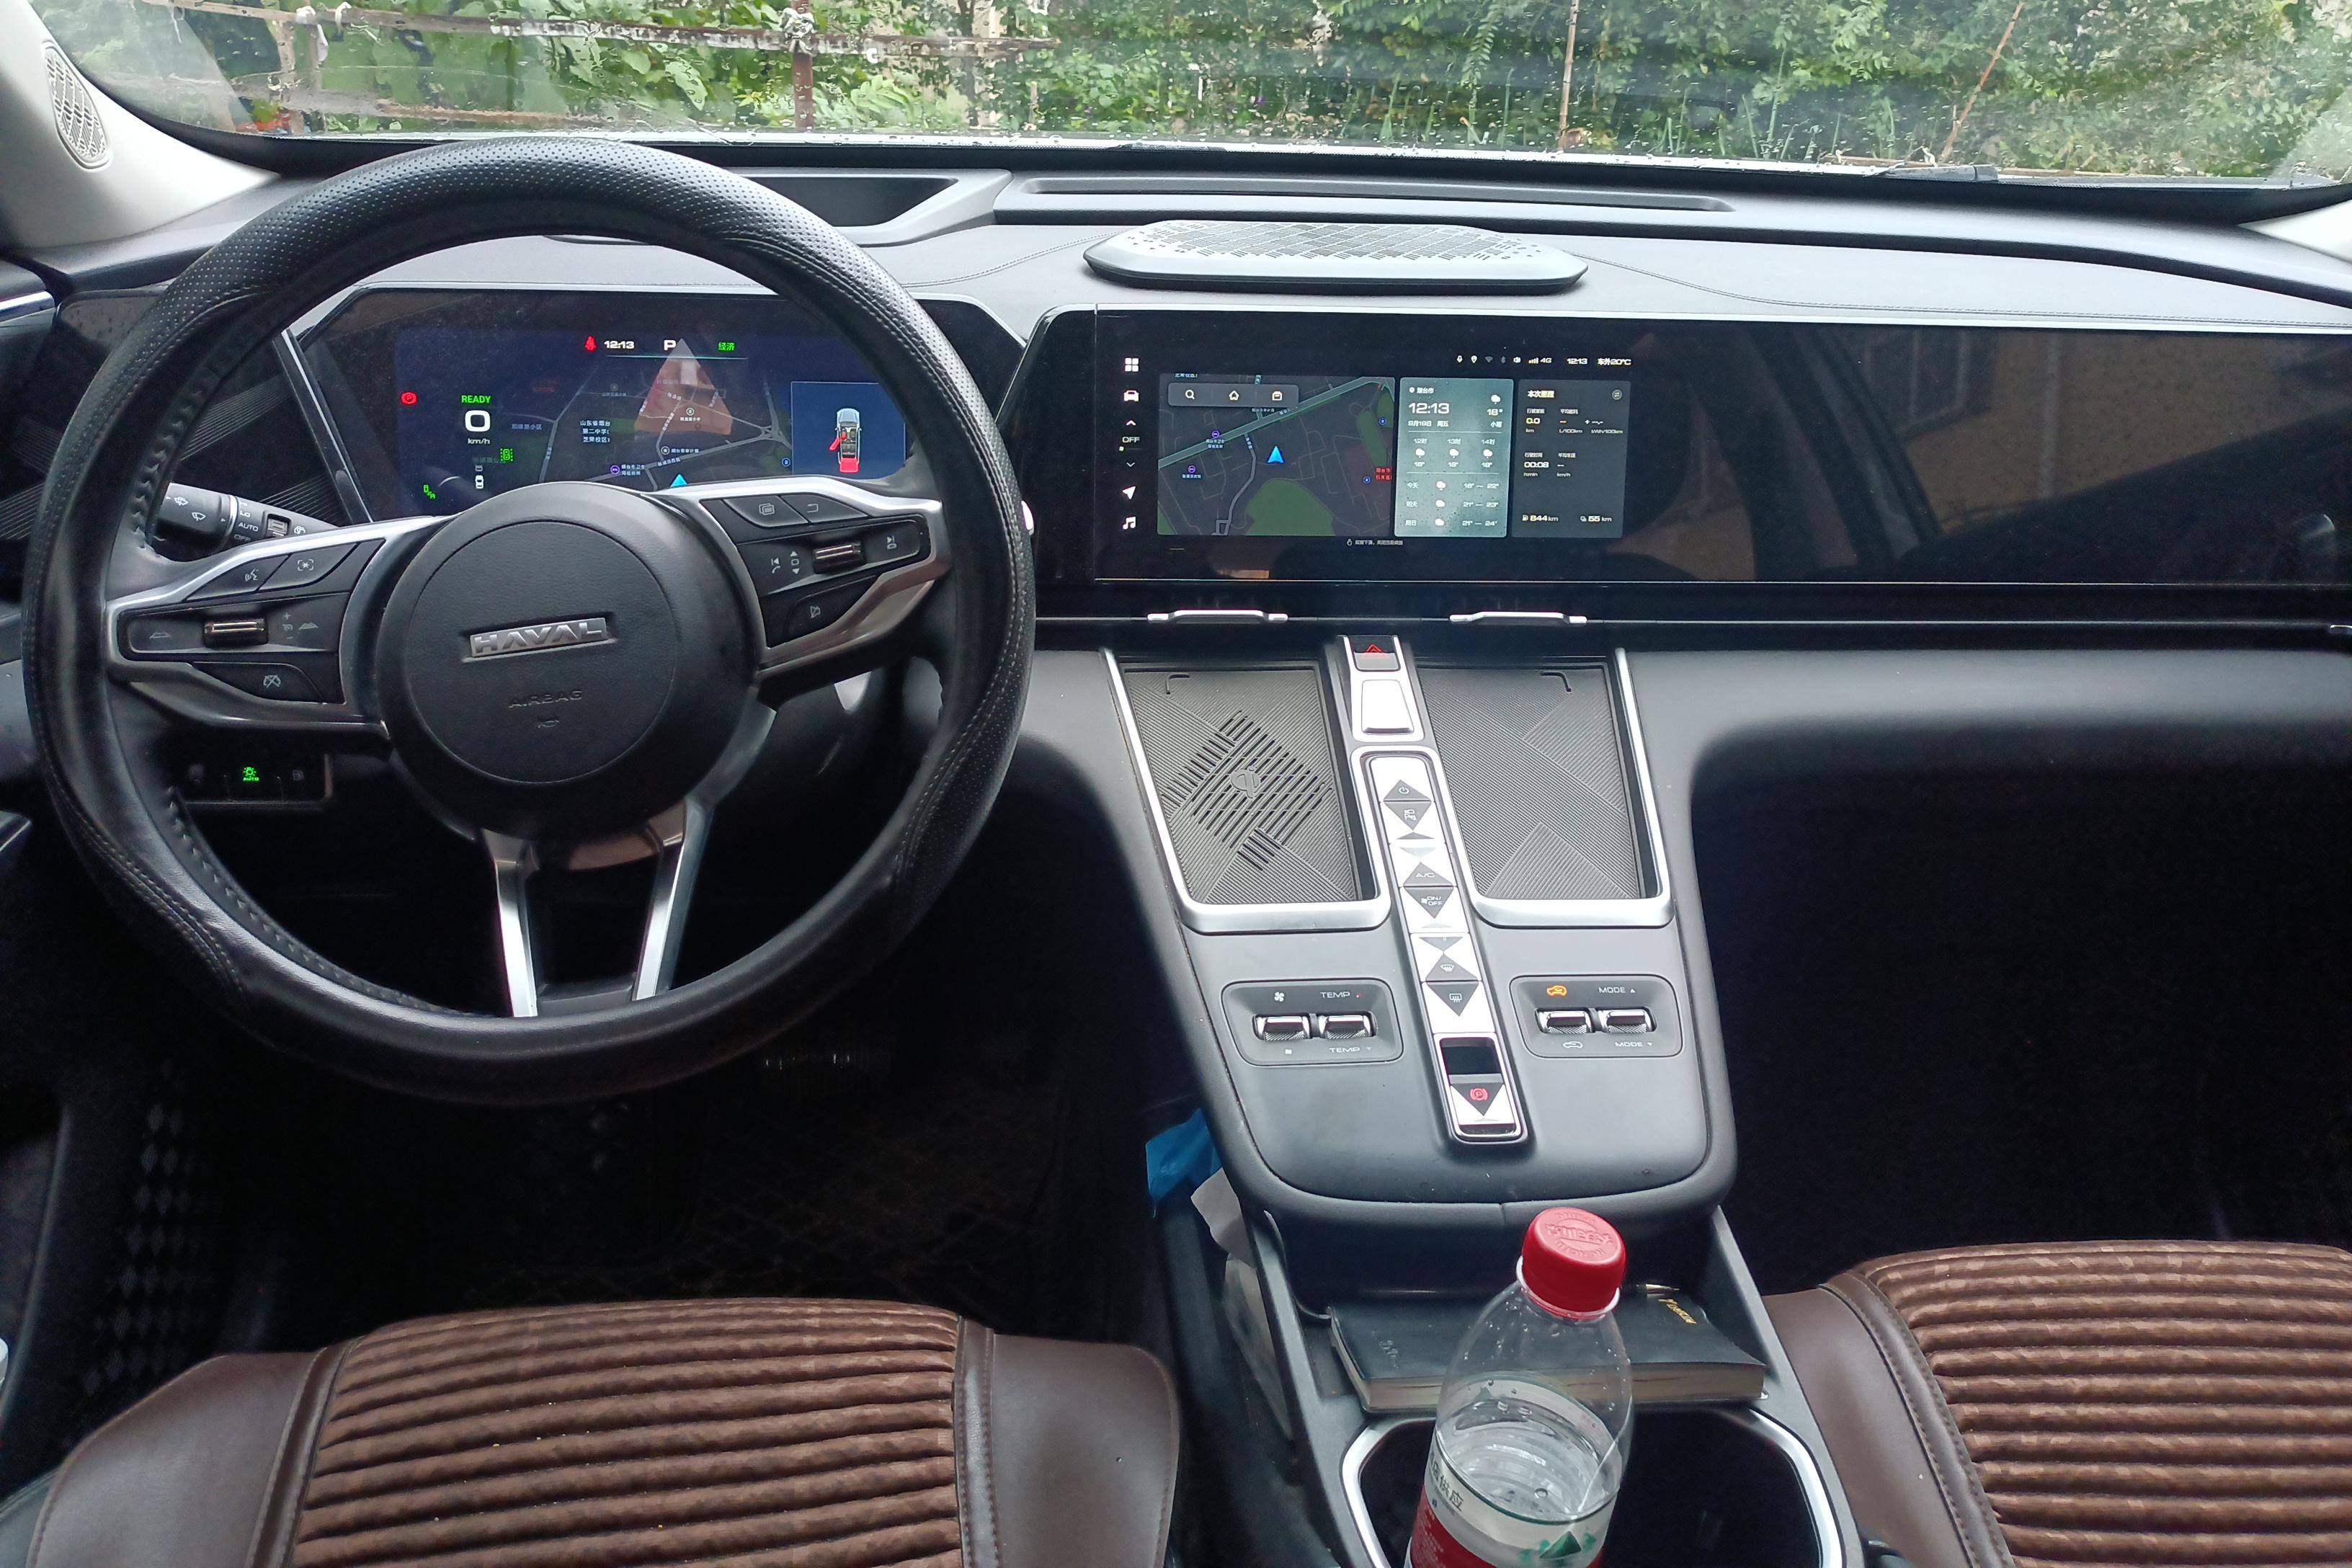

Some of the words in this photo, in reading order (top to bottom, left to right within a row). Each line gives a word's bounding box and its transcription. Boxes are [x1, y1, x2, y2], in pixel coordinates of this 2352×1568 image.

[603, 340, 635, 349] 12:13
[663, 339, 677, 351] P
[718, 341, 736, 352] 经济
[461, 395, 491, 404] READY
[1409, 402, 1450, 414] 12:13
[465, 409, 491, 432] 0
[238, 522, 259, 532] AUTO
[473, 621, 603, 654] HAVAL
[508, 690, 582, 708] AIRBAG
